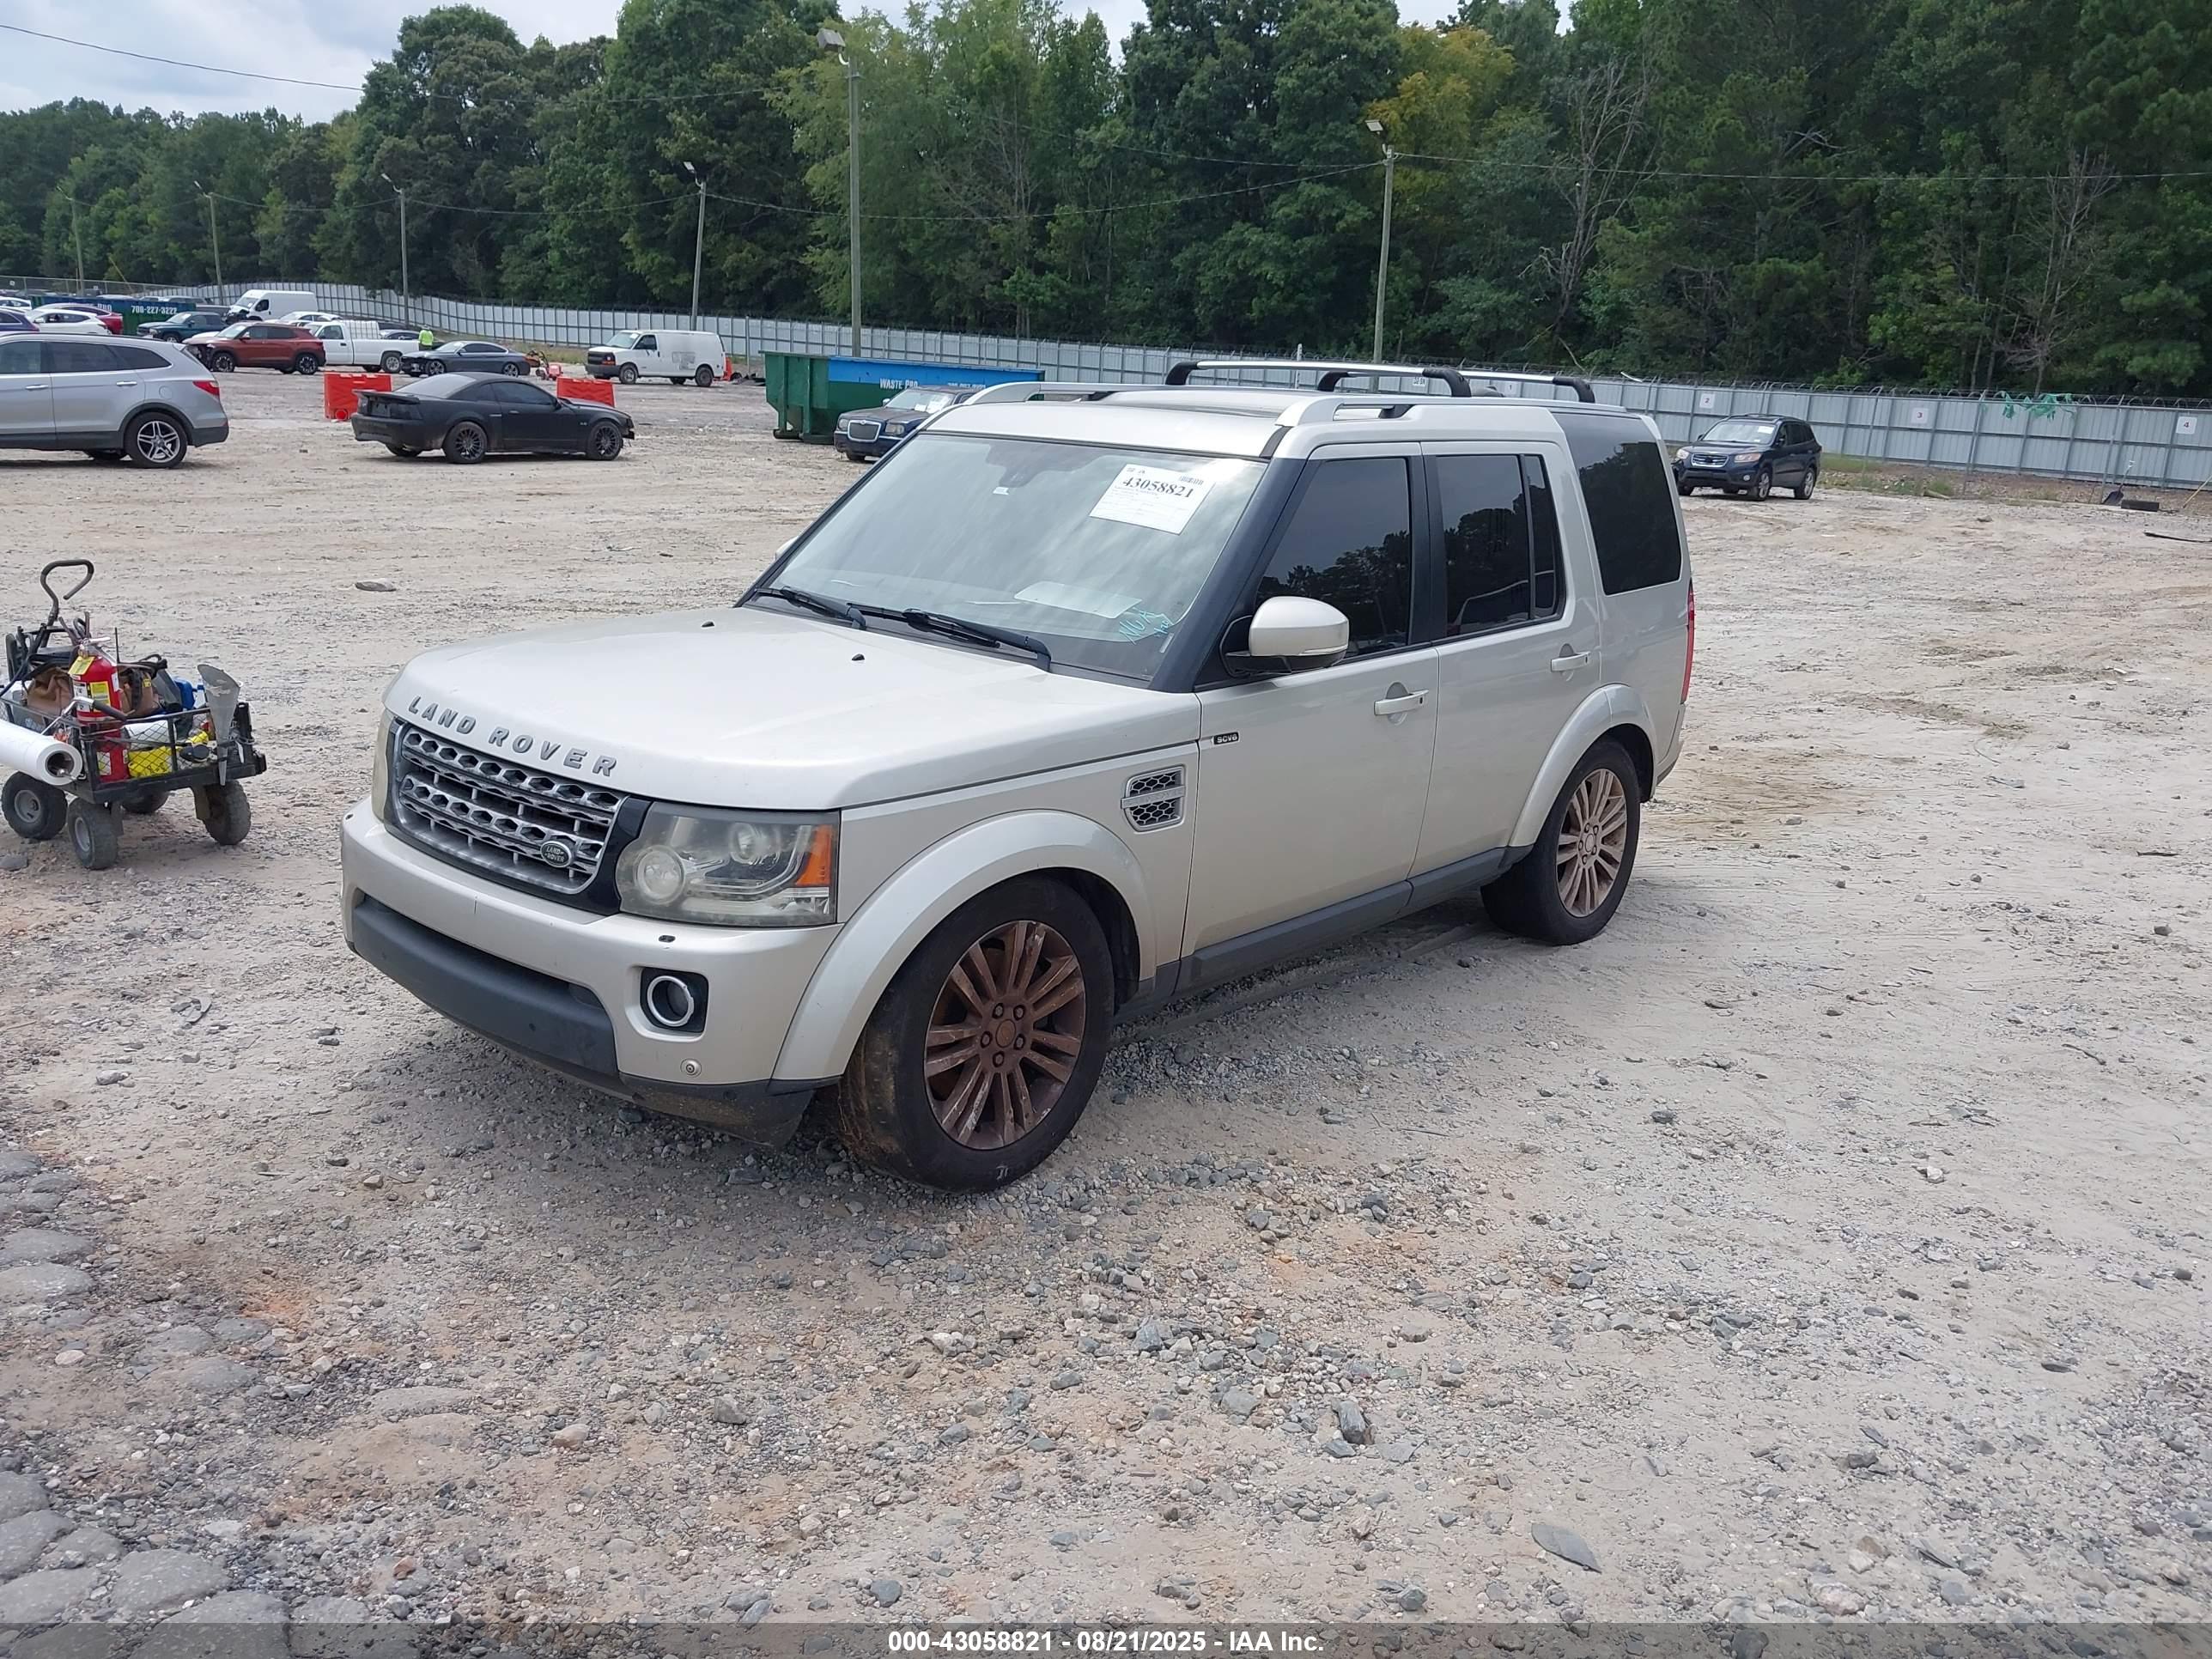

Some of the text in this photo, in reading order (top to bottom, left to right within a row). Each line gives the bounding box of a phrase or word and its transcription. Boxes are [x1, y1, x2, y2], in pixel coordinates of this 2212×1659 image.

[879, 378, 903, 390] WASTE
[1122, 477, 1194, 498] 43058821
[408, 695, 617, 777] LAND ROVER
